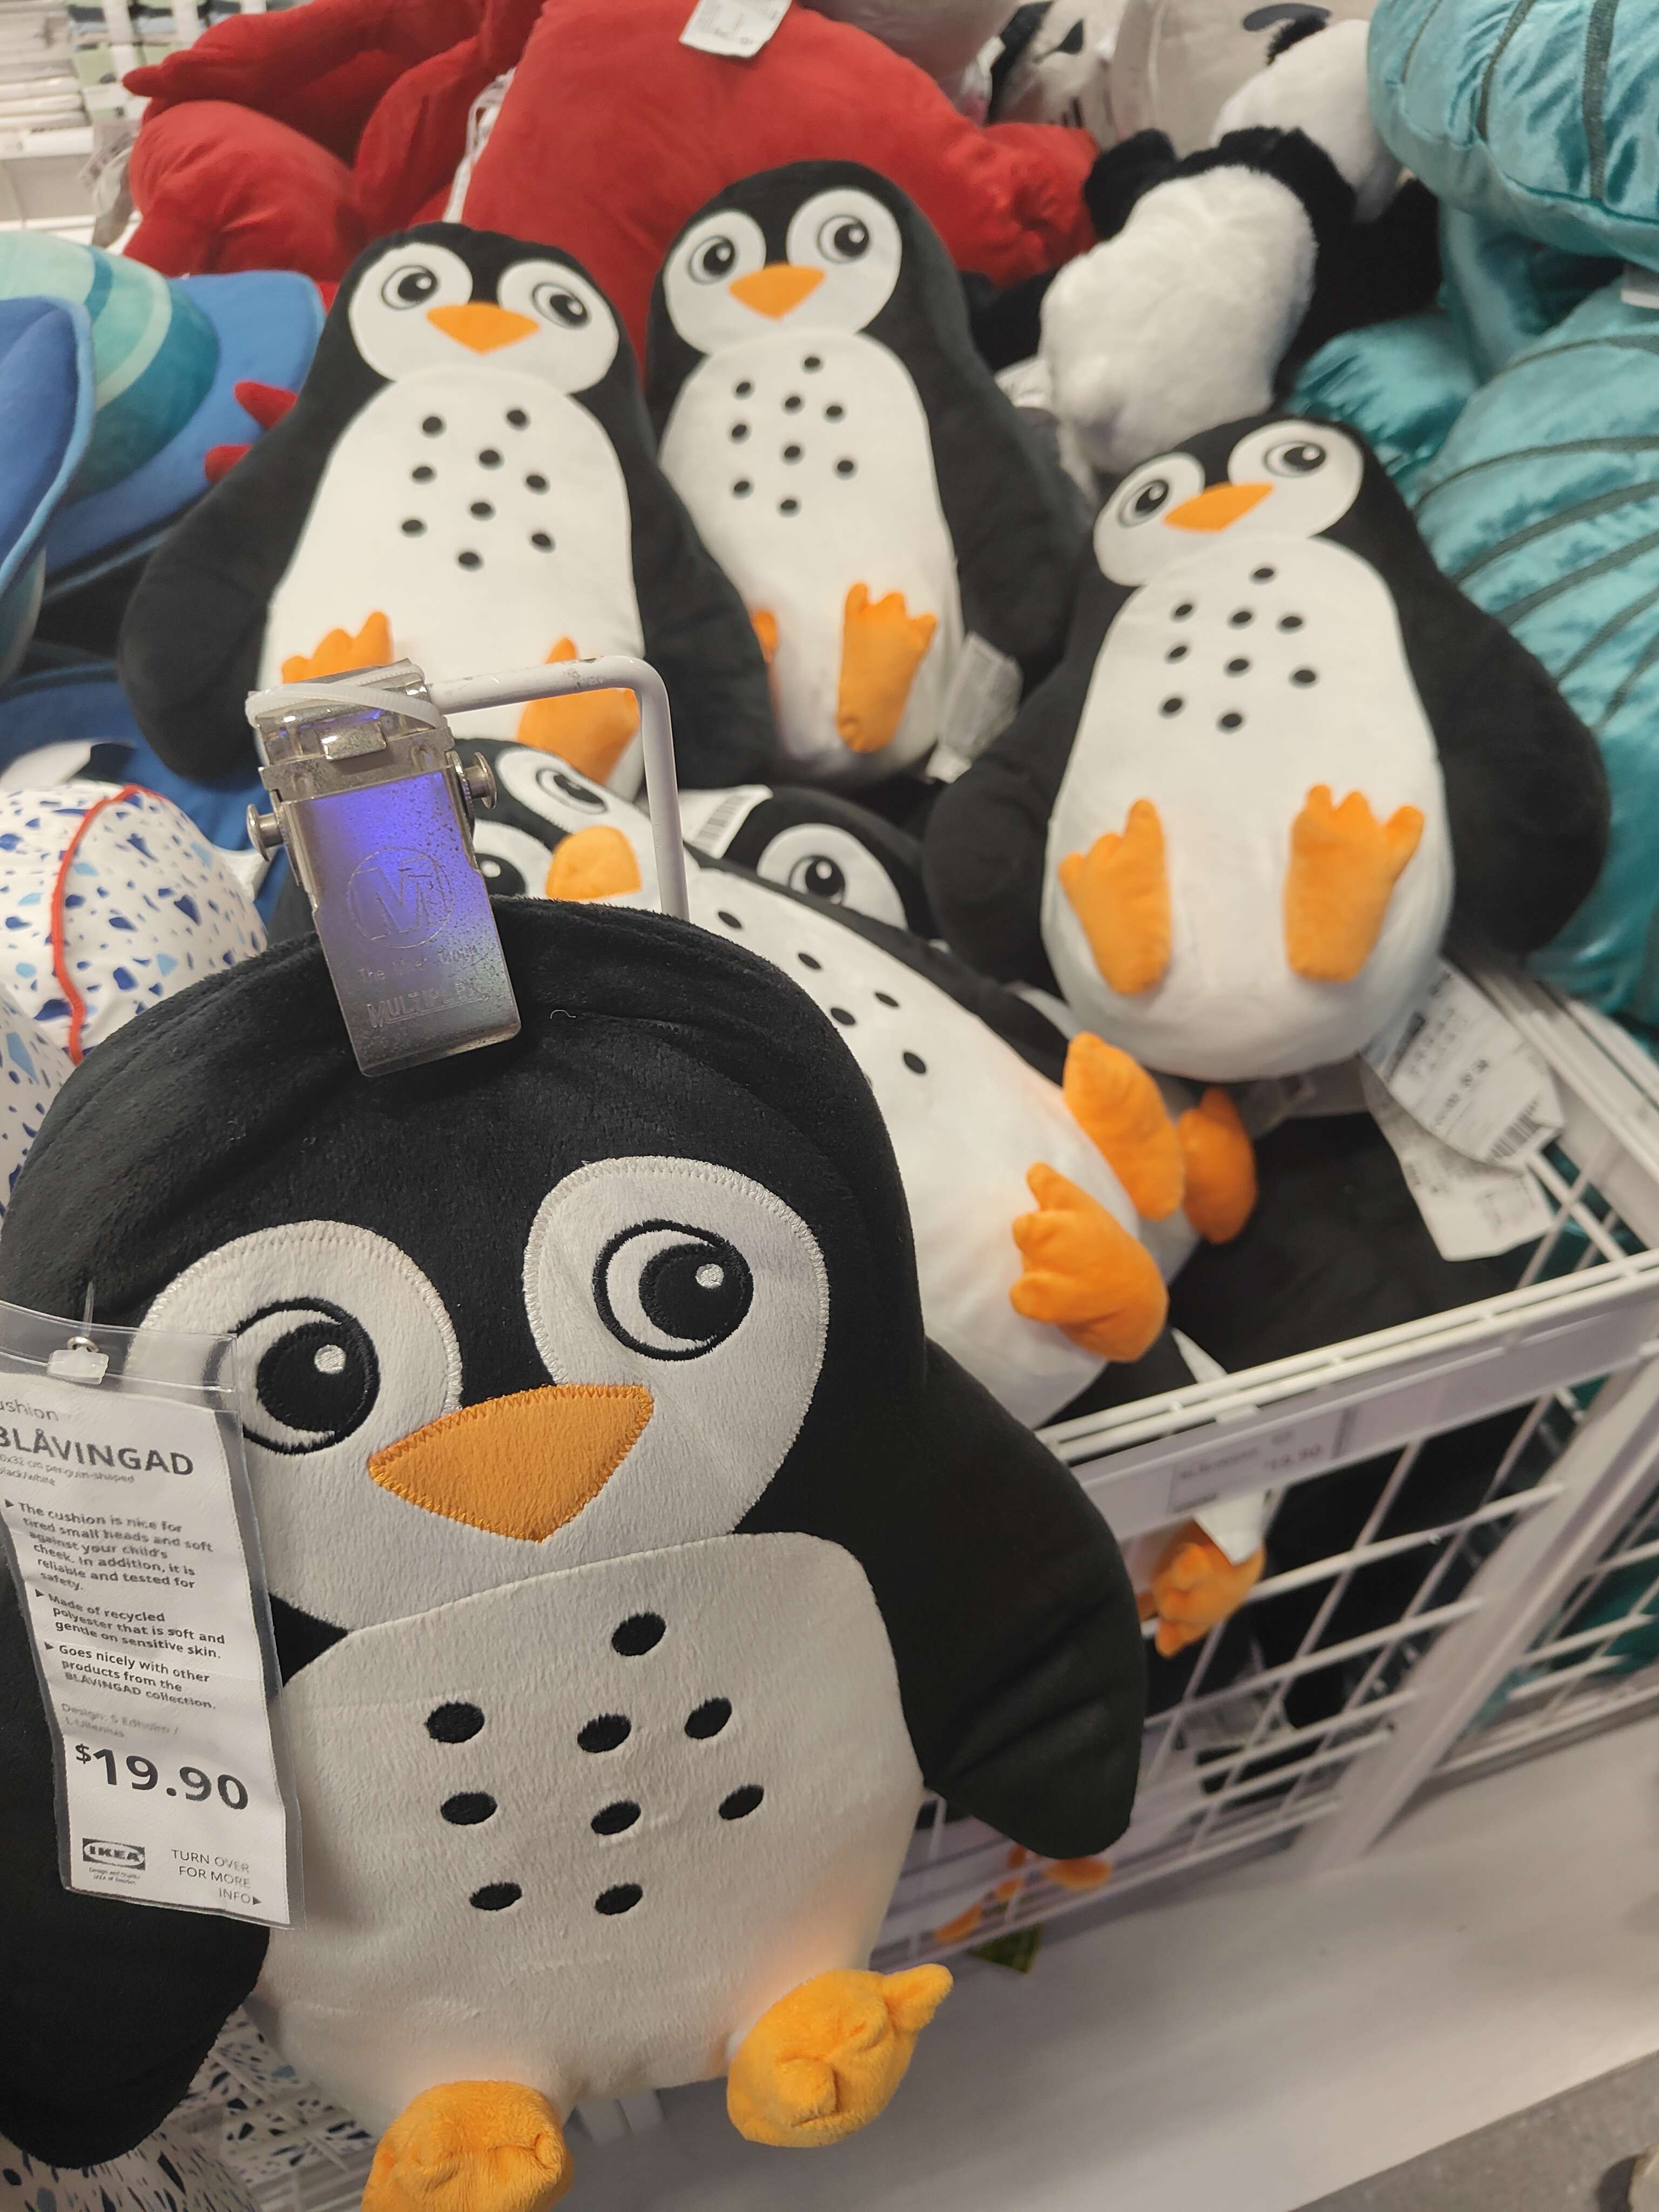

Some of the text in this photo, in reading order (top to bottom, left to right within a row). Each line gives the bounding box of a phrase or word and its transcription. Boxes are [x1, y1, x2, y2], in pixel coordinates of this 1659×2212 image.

[0, 1426, 194, 1476] BLÅVINGAD
[18, 1502, 44, 1516] The
[48, 1510, 106, 1525] cushion
[110, 1514, 123, 1526] is
[161, 1520, 183, 1533] for
[23, 1517, 214, 1553] tired small heads and soft
[29, 1531, 79, 1551] against
[81, 1544, 117, 1555] your
[38, 1559, 195, 1588] reliable and tested for
[78, 1556, 93, 1566] In
[168, 1562, 180, 1574] it
[183, 1564, 195, 1576] is
[41, 1572, 84, 1591] safety.
[48, 1593, 166, 1623] Made of recycled
[53, 1607, 226, 1644] polyester that is soft and
[55, 1621, 221, 1659] gentle on sensitive skin.
[59, 1644, 210, 1682] Goes nicely with other
[62, 1660, 183, 1692] products from the
[145, 1690, 216, 1709] collection.
[75, 1743, 249, 1810] $19.90
[89, 1845, 140, 1862] IKEA
[171, 1849, 249, 1874] TURN OVER
[179, 1866, 251, 1889] FOR MORE
[219, 1887, 251, 1904] INFO
